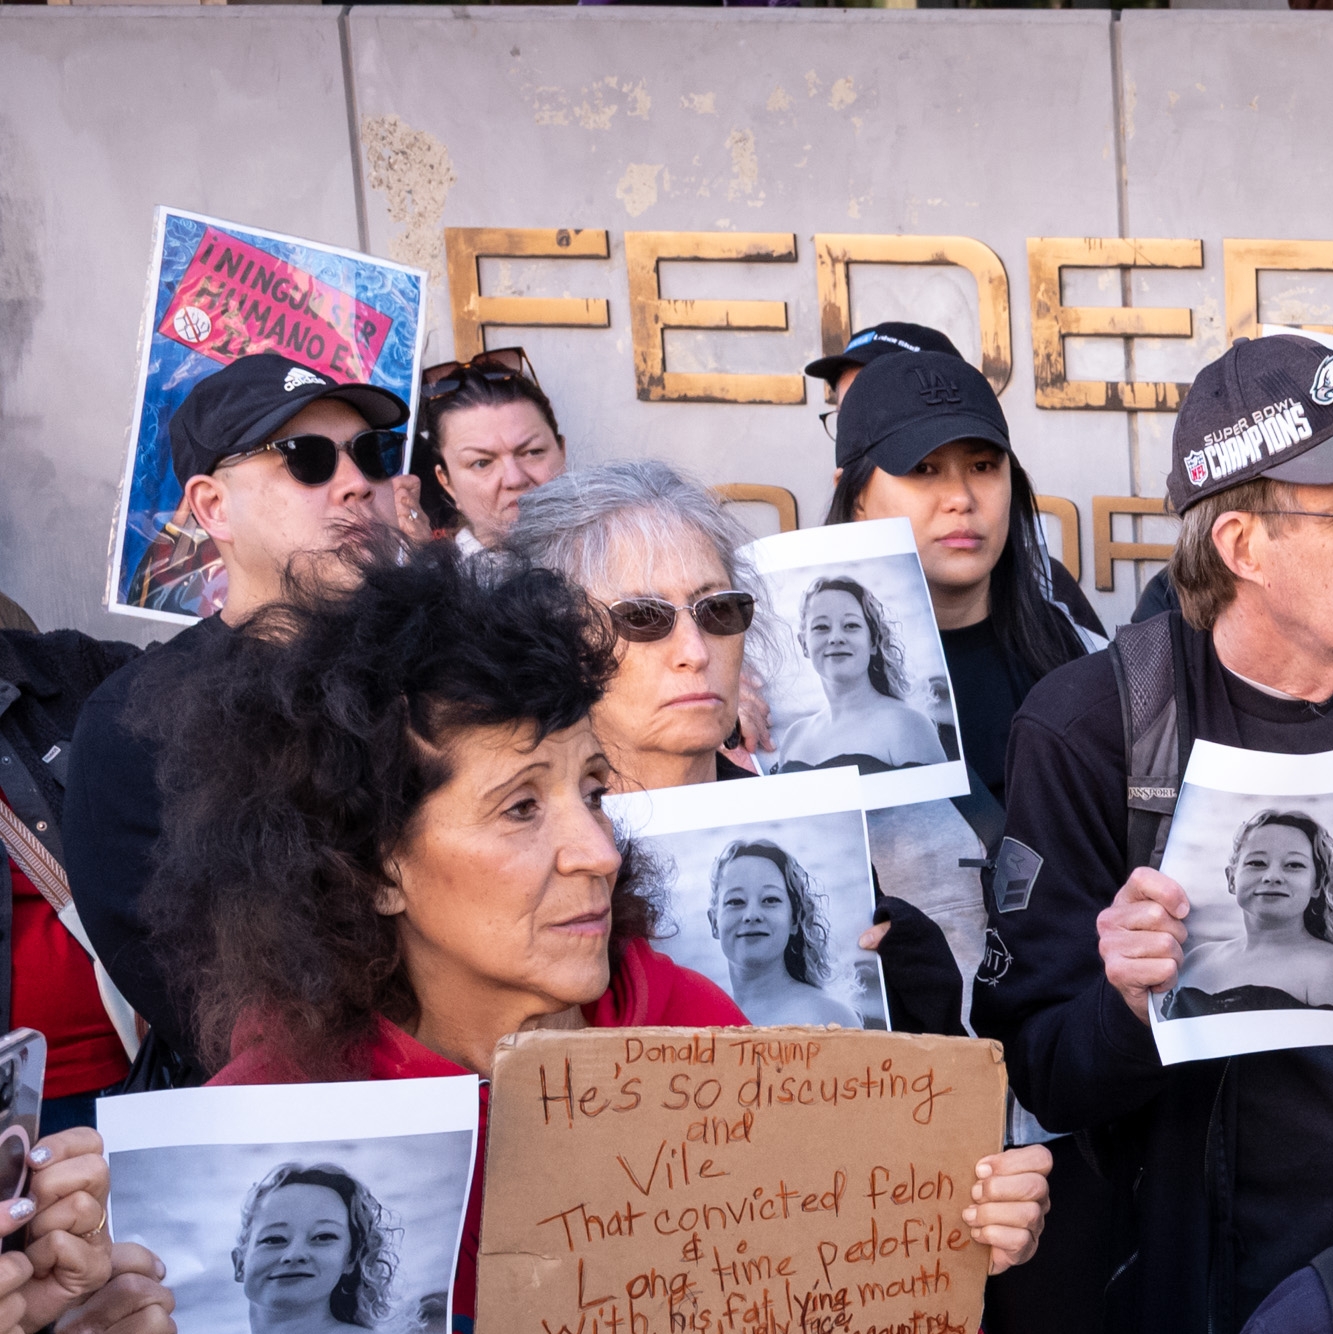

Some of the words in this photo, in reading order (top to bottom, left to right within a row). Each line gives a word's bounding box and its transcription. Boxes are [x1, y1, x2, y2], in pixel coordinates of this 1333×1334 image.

[193, 275, 326, 360] HUMANO
[329, 343, 366, 379] ES
[327, 302, 378, 345] SER
[284, 374, 327, 392] adidas
[912, 367, 962, 406] LA
[1203, 417, 1250, 447] SUPER
[1251, 398, 1301, 424] BOWL
[1204, 403, 1313, 481] CHAMPIONS
[1190, 464, 1207, 481] NFL
[624, 1034, 716, 1066] Donald
[538, 1056, 642, 1129] He's
[737, 1055, 953, 1124] discusting
[686, 1108, 754, 1145] and
[616, 1140, 731, 1196] Vile
[536, 1202, 647, 1254] That
[653, 1168, 848, 1236] convicted
[867, 1163, 955, 1206] felon
[711, 1240, 797, 1292] time
[818, 1214, 972, 1290] pedofile
[669, 1293, 712, 1334] his
[722, 1288, 774, 1330] fat
[857, 1258, 952, 1307] mouth
